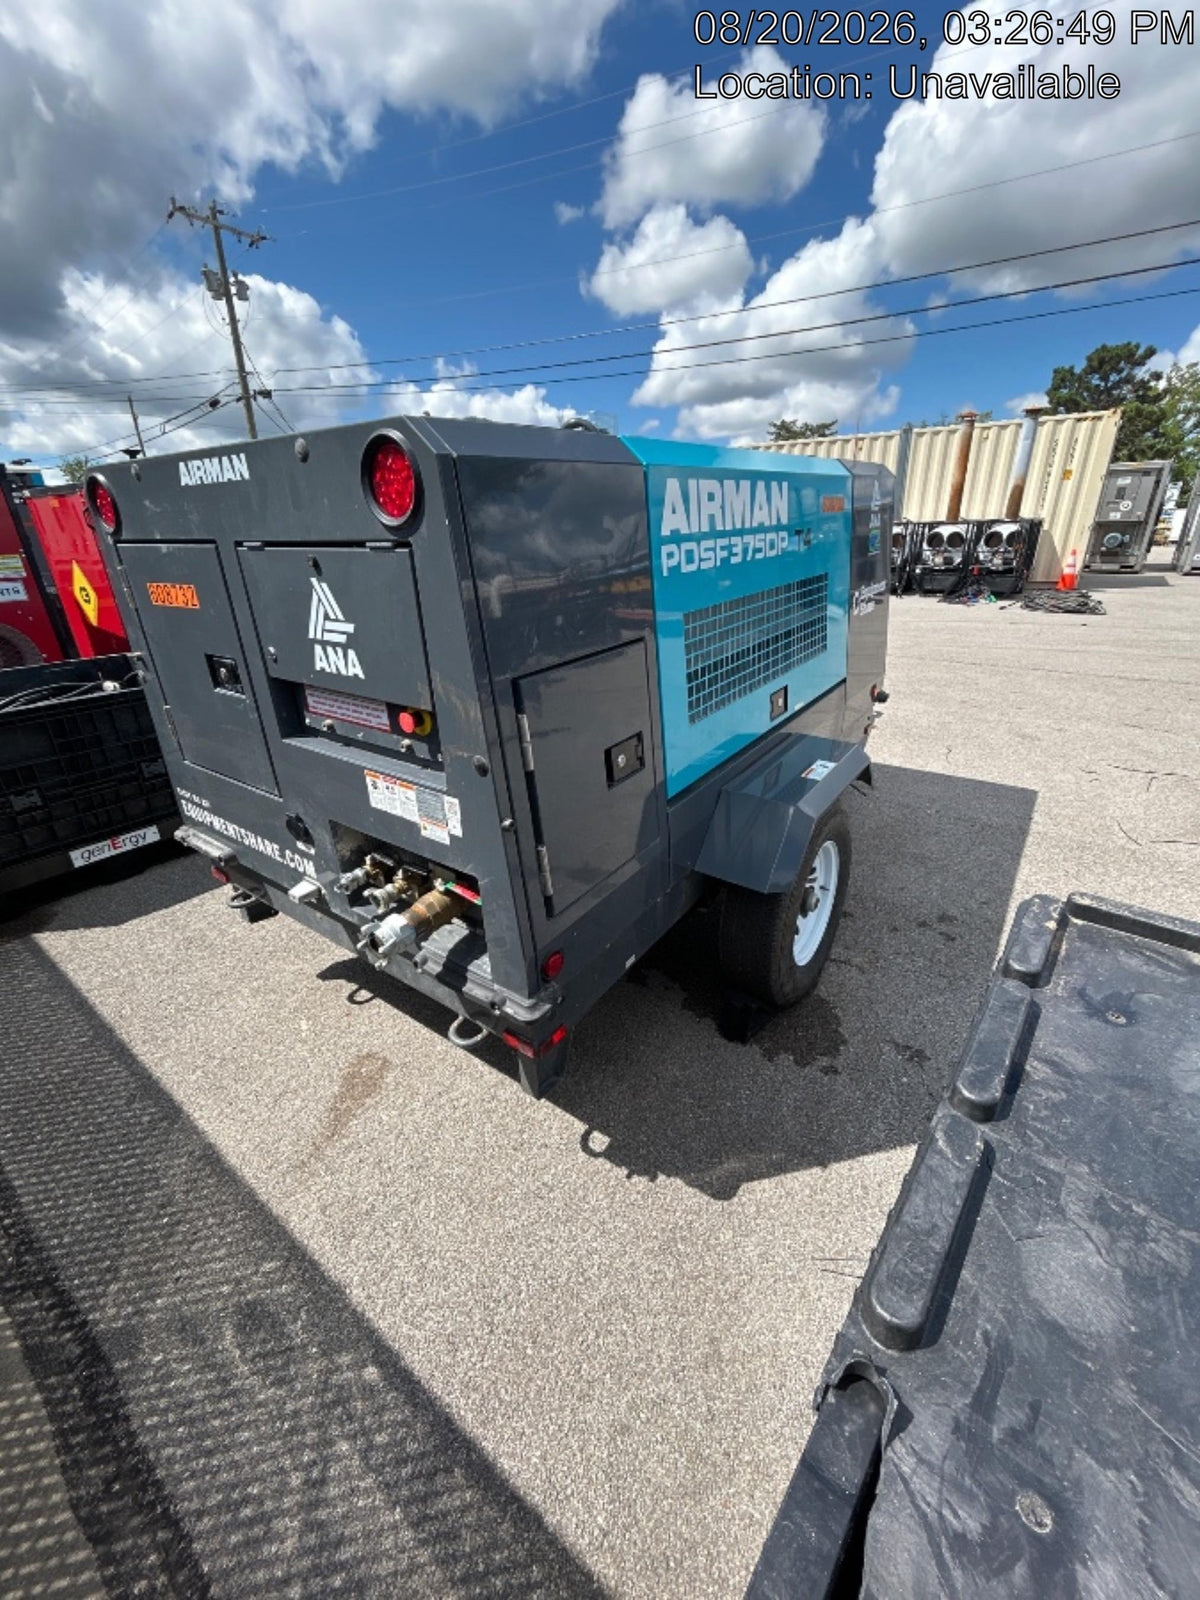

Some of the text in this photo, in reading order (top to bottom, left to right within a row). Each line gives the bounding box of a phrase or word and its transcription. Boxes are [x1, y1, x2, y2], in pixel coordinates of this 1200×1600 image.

[178, 452, 251, 487] AIRMAN
[660, 478, 789, 536] AIRMAN
[660, 531, 788, 577] PDSF375DP
[313, 643, 366, 680] ANA
[180, 799, 318, 879] EQUIPMENTSHARE.COM
